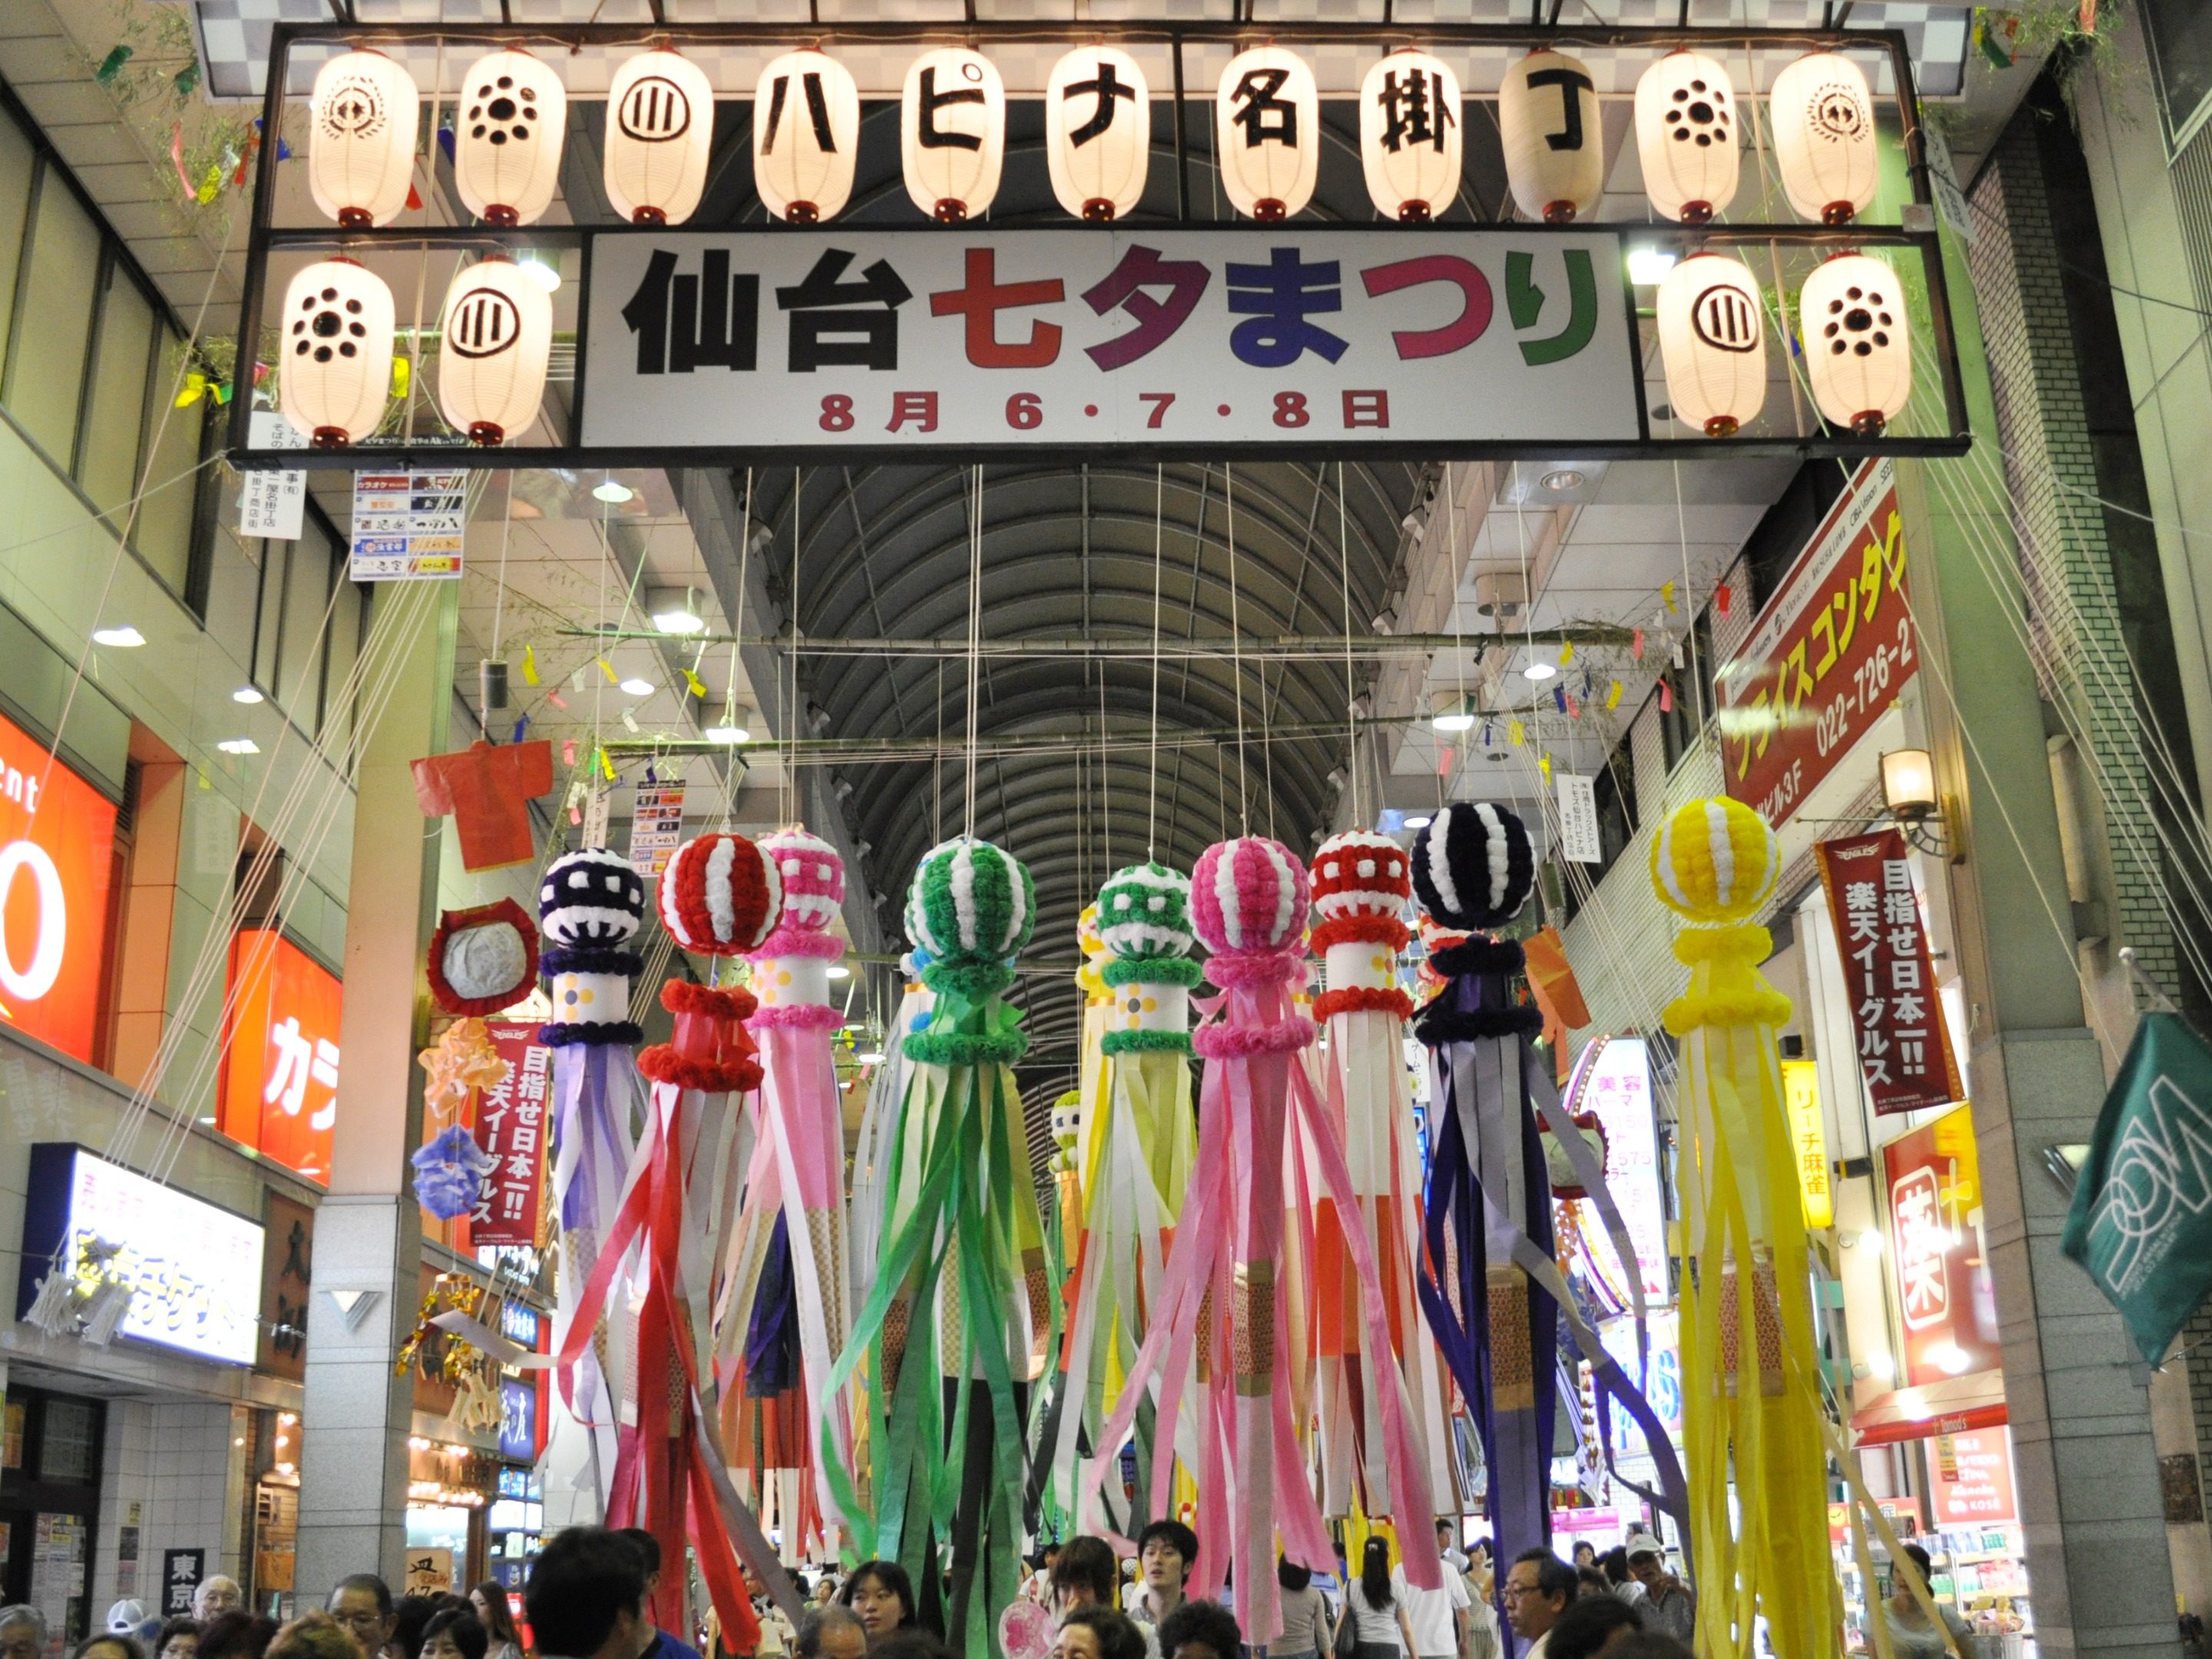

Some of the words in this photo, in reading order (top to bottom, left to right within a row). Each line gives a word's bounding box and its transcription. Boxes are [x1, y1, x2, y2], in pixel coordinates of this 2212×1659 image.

[621, 243, 1598, 374] 仙台七夕まつり
[1816, 614, 1915, 758] 022-726-2
[1846, 881, 1892, 1087] 楽天イーグルス
[264, 1016, 340, 1131] カラ
[1598, 1076, 1641, 1091] 美容
[1796, 1089, 1826, 1195] リーチ麻雀
[1941, 1413, 1967, 1434] Tomod's
[171, 1554, 198, 1618] 東京
